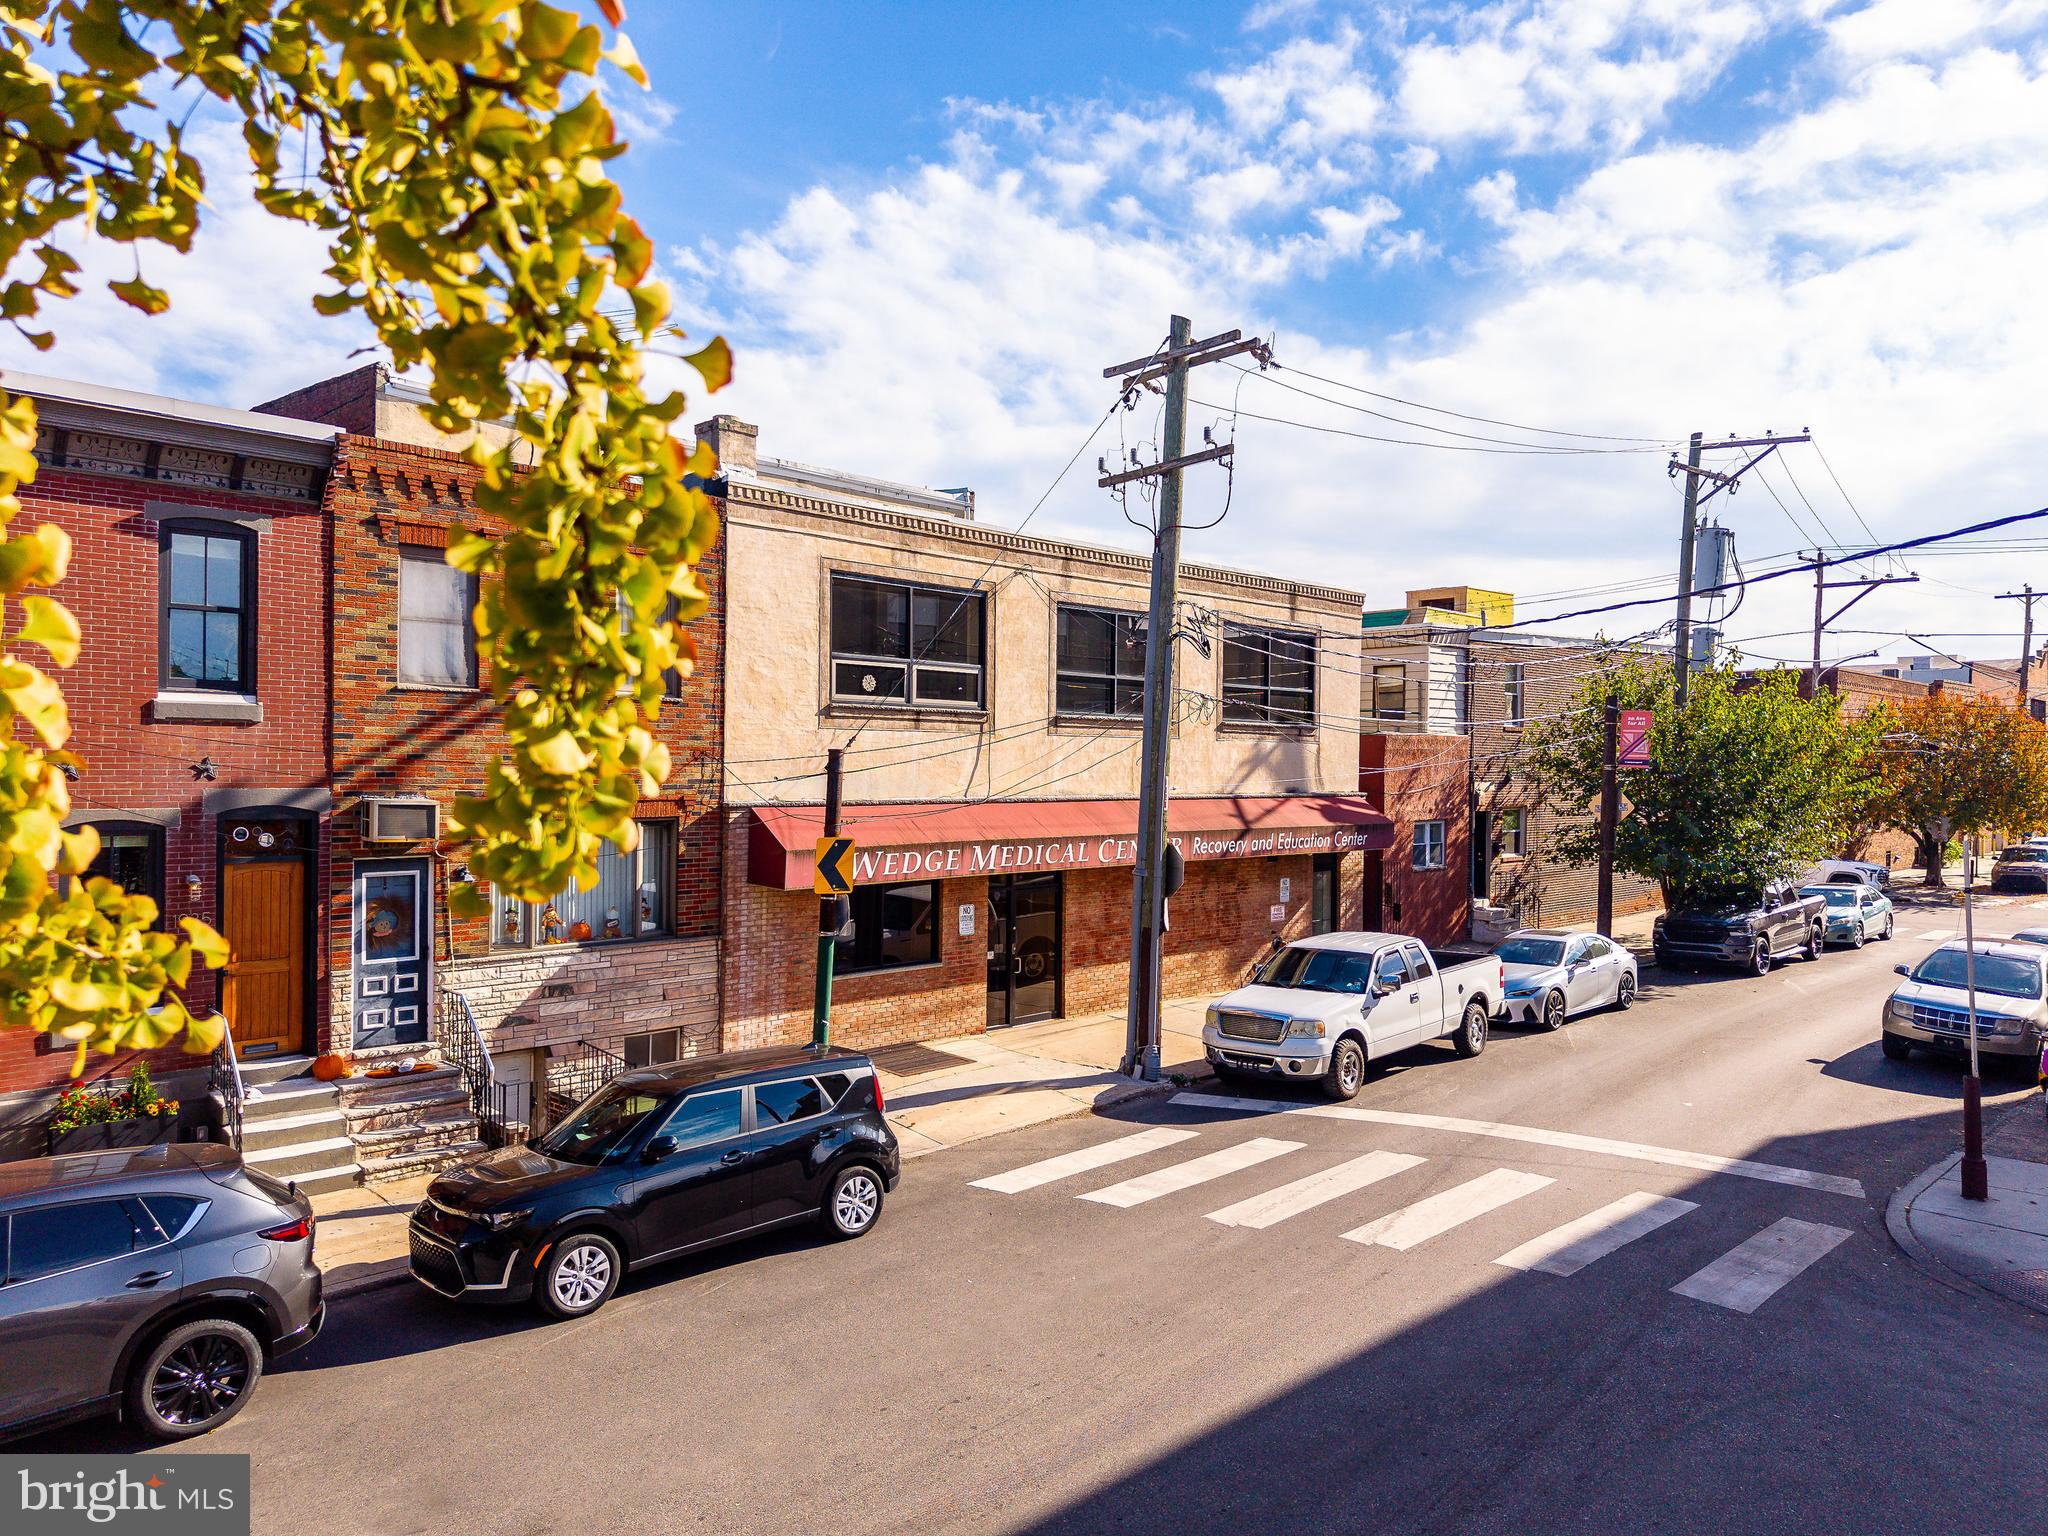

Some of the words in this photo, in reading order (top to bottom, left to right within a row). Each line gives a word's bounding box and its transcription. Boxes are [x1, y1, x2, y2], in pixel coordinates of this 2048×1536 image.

[1193, 836, 1248, 857] Recovery
[1251, 833, 1274, 851] and
[1277, 832, 1331, 850] Education
[1334, 831, 1368, 847] Center
[853, 849, 961, 880] WEDGE
[968, 842, 1090, 871] MEDICAL
[962, 906, 971, 915] NO
